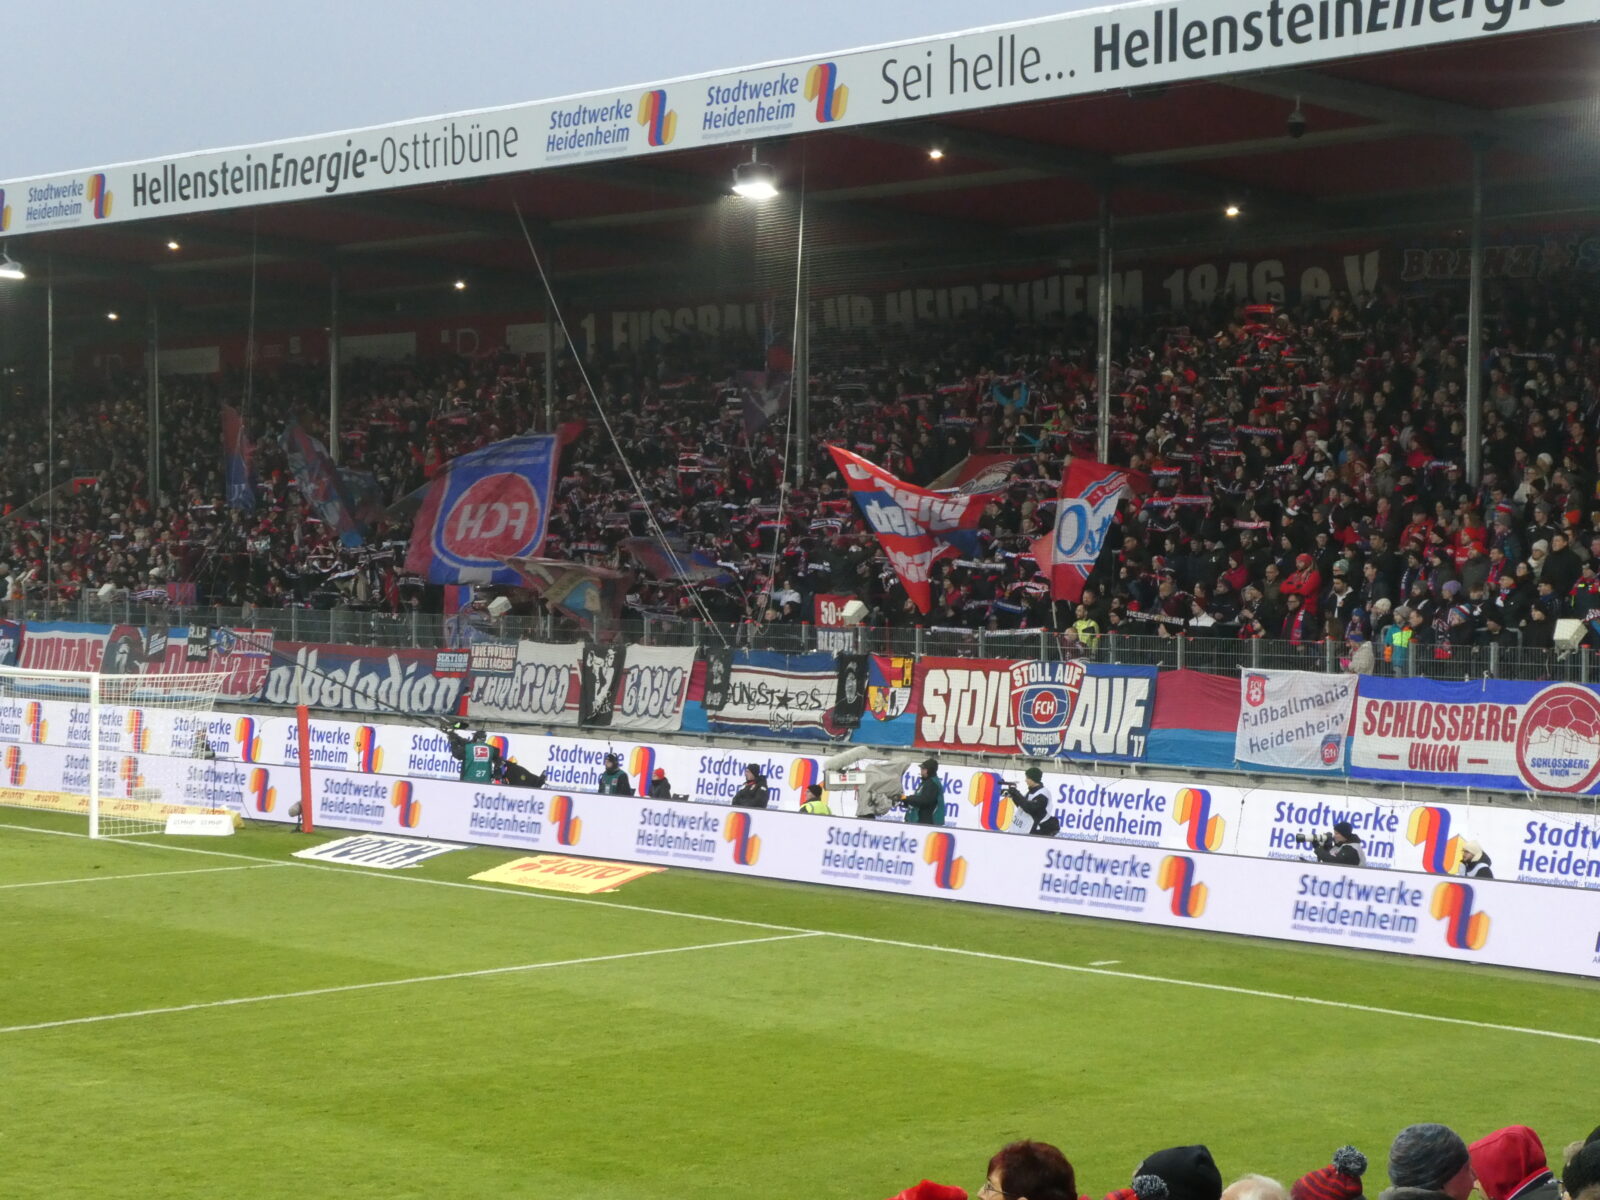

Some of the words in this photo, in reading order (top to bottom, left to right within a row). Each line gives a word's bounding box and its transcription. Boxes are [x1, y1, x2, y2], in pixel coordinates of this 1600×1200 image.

[1093, 0, 1566, 74] HellensteinEnerg
[881, 51, 933, 104] Sei
[949, 34, 1076, 96] helle...
[706, 72, 800, 107] Stadtwerke
[549, 99, 633, 131] Stadtwerke
[702, 100, 796, 131] Heidenheim
[545, 125, 630, 153] Heidenheim
[132, 123, 519, 208] HellensteinEnergie-Osttribüne
[27, 181, 84, 204] Stadtwerke
[25, 200, 82, 222] Heidenheim
[1012, 662, 1052, 688] STOLL
[1054, 662, 1082, 686] AUF
[920, 668, 1016, 746] STOLL
[1063, 676, 1150, 755] AUF
[1034, 701, 1055, 716] FCH
[1241, 682, 1350, 731] Fußballmania
[1248, 712, 1345, 755] Heidenheim
[1362, 699, 1518, 744] SCHLOSSBERG
[1408, 742, 1461, 772] UNION
[1530, 757, 1590, 769] SCHLOSSBERG
[475, 769, 487, 777] 27
[1550, 768, 1571, 777] UNION
[322, 778, 388, 800] Stadtwerke
[1056, 783, 1167, 813] Stadtwerke
[319, 796, 386, 819] Heidenheim
[472, 792, 545, 816] Stadtwerke
[1274, 800, 1399, 833] Stadtwerke
[469, 811, 542, 835] Heidenheim
[639, 808, 720, 833] Stadtwerke
[1054, 808, 1163, 837] Heidenheim
[635, 829, 717, 854] Heidenheim
[826, 827, 918, 854] Stadtwerke
[821, 849, 914, 877] Heidenheim
[1044, 848, 1151, 879] Stadtwerke
[1518, 849, 1600, 878] Heiden
[1039, 872, 1147, 904] Heidenheim
[1297, 873, 1423, 908] Stadtwerke
[1292, 899, 1418, 934] Heidenheim
